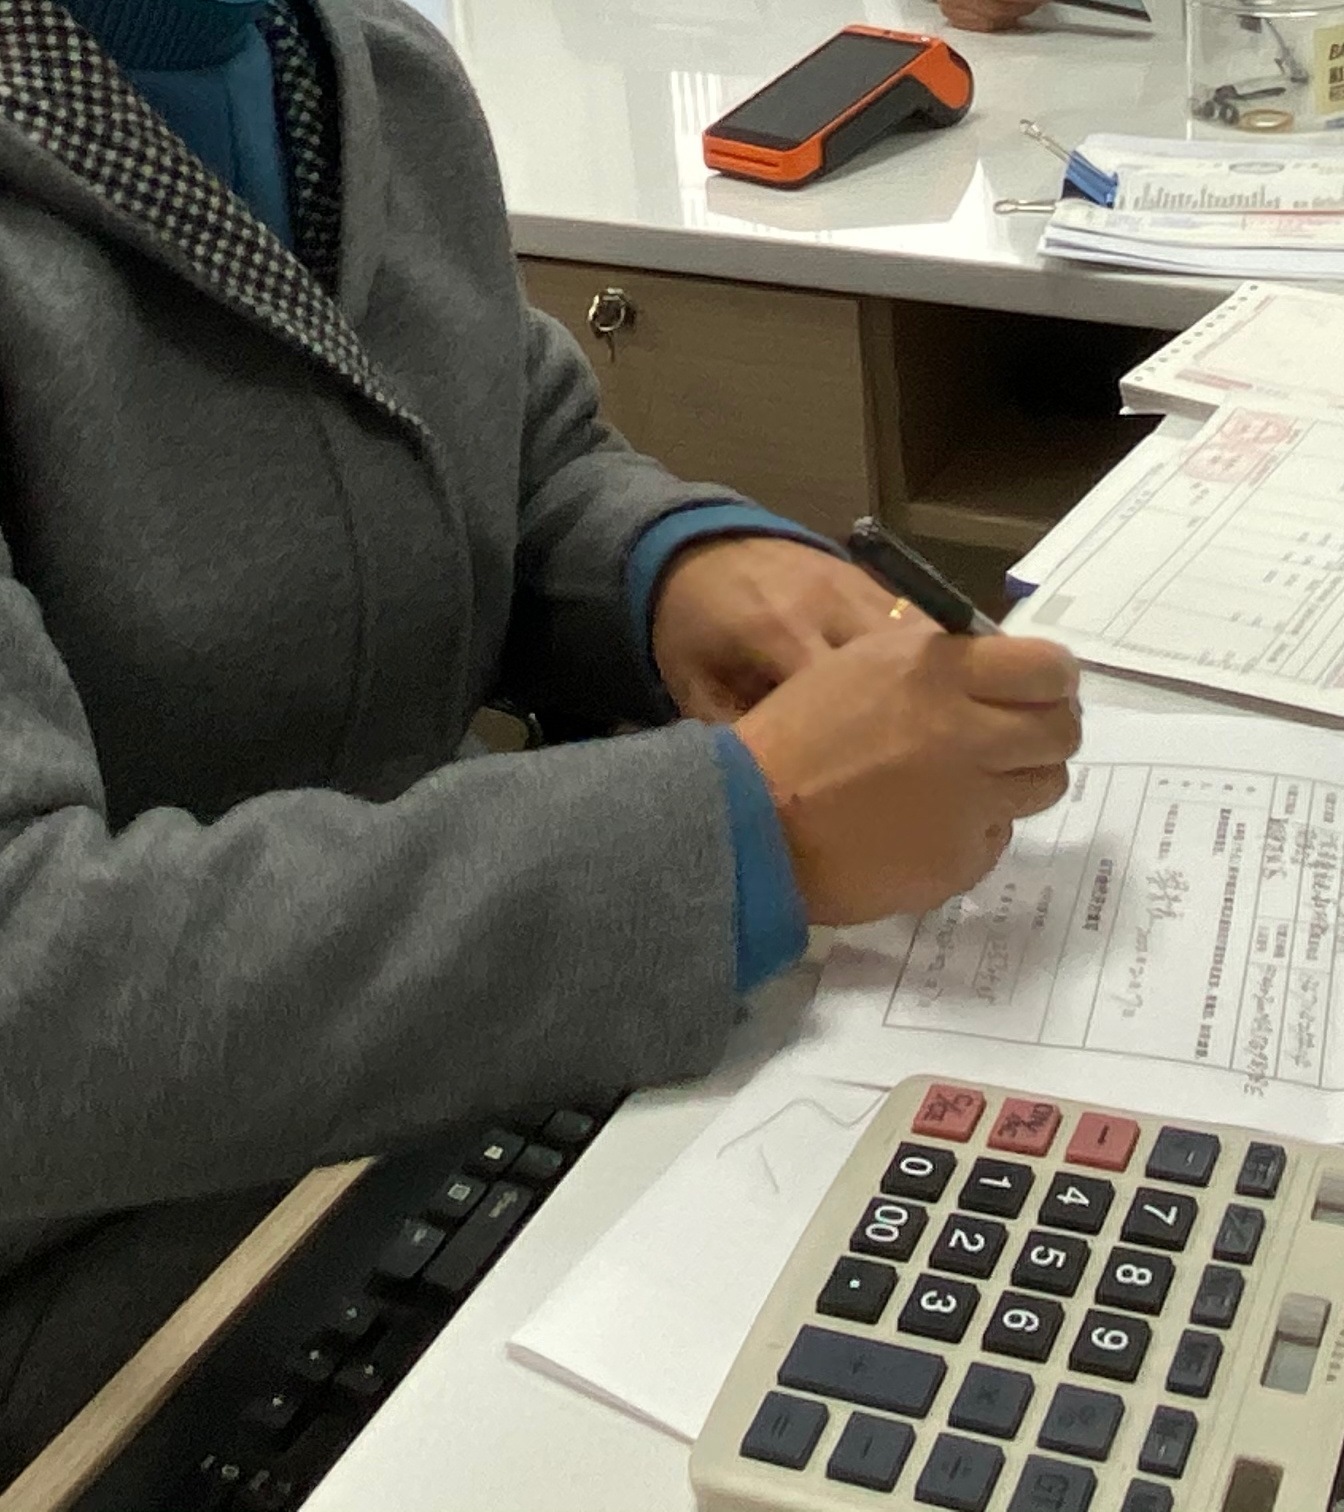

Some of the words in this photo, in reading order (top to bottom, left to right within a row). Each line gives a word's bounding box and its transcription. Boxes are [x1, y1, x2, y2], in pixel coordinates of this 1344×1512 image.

[899, 1155, 934, 1176] 0
[978, 1175, 1012, 1190] 1
[1056, 1186, 1090, 1208] 4
[865, 1205, 909, 1243] 00
[1143, 1203, 1178, 1226] 7
[948, 1228, 985, 1252] 2
[1030, 1245, 1067, 1269] 5
[1115, 1263, 1153, 1286] 8
[920, 1290, 957, 1314] 3
[1002, 1308, 1040, 1332] 6
[1091, 1326, 1129, 1352] 9
